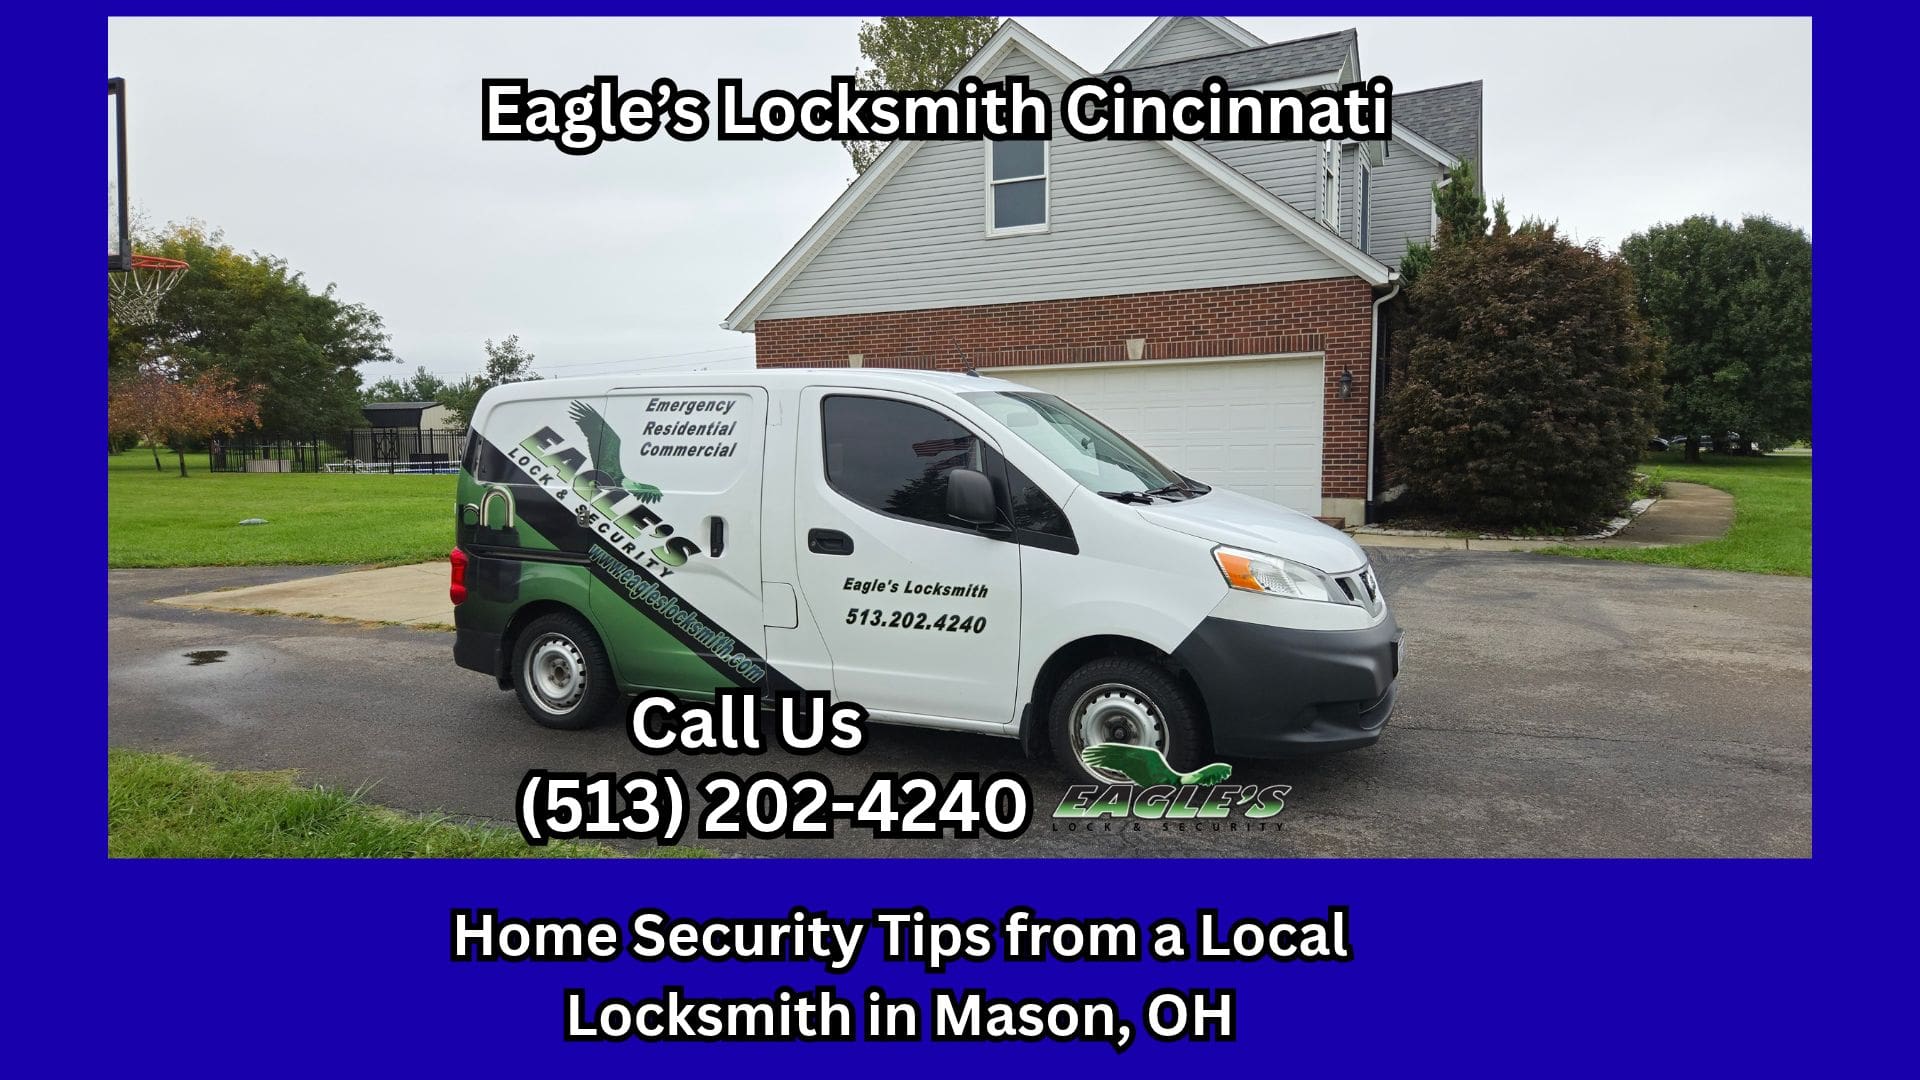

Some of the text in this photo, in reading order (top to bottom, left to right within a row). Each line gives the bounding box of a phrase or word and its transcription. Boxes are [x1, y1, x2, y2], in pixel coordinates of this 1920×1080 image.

[645, 397, 737, 417] Emergency
[642, 421, 737, 437] Residential
[640, 441, 737, 458] Commercial
[519, 425, 703, 568] EAGLE'S
[507, 447, 675, 578] LOCK & SECURITY
[842, 577, 989, 599] Eagle's Locksmith
[587, 543, 766, 684] www.eagleslocksmith.com
[845, 607, 987, 635] 513.202.4240
